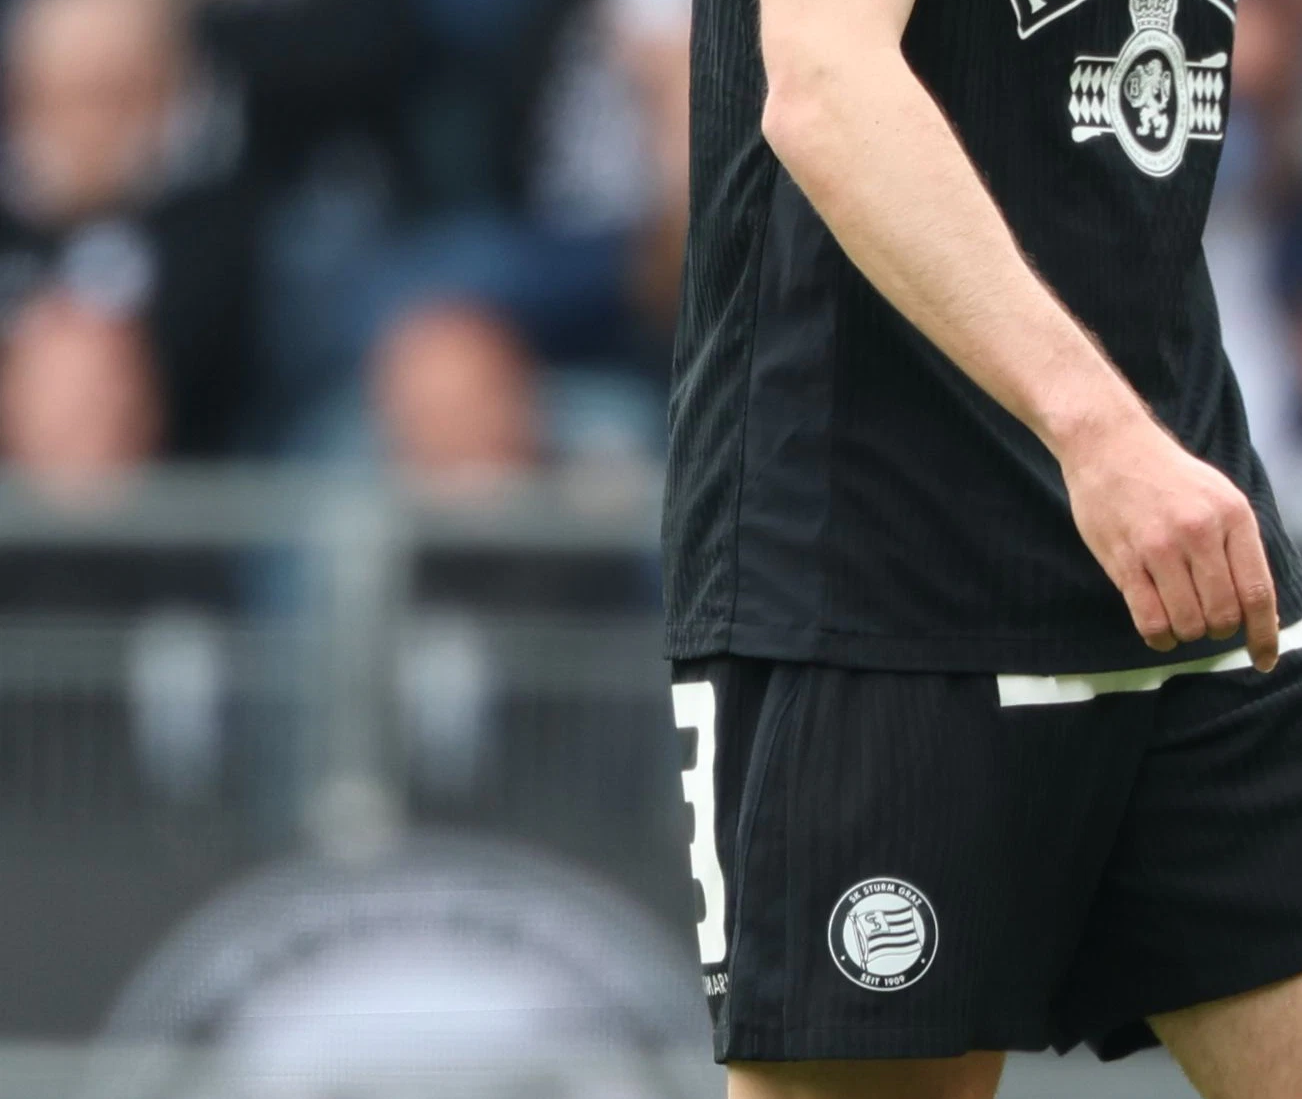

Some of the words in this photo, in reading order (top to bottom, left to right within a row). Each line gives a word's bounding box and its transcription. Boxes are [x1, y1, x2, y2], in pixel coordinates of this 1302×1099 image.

[848, 891, 862, 904] SK
[863, 882, 896, 896] STURM
[898, 886, 923, 907] GRAZ
[860, 973, 880, 986] SEIT
[884, 974, 905, 986] 1909
